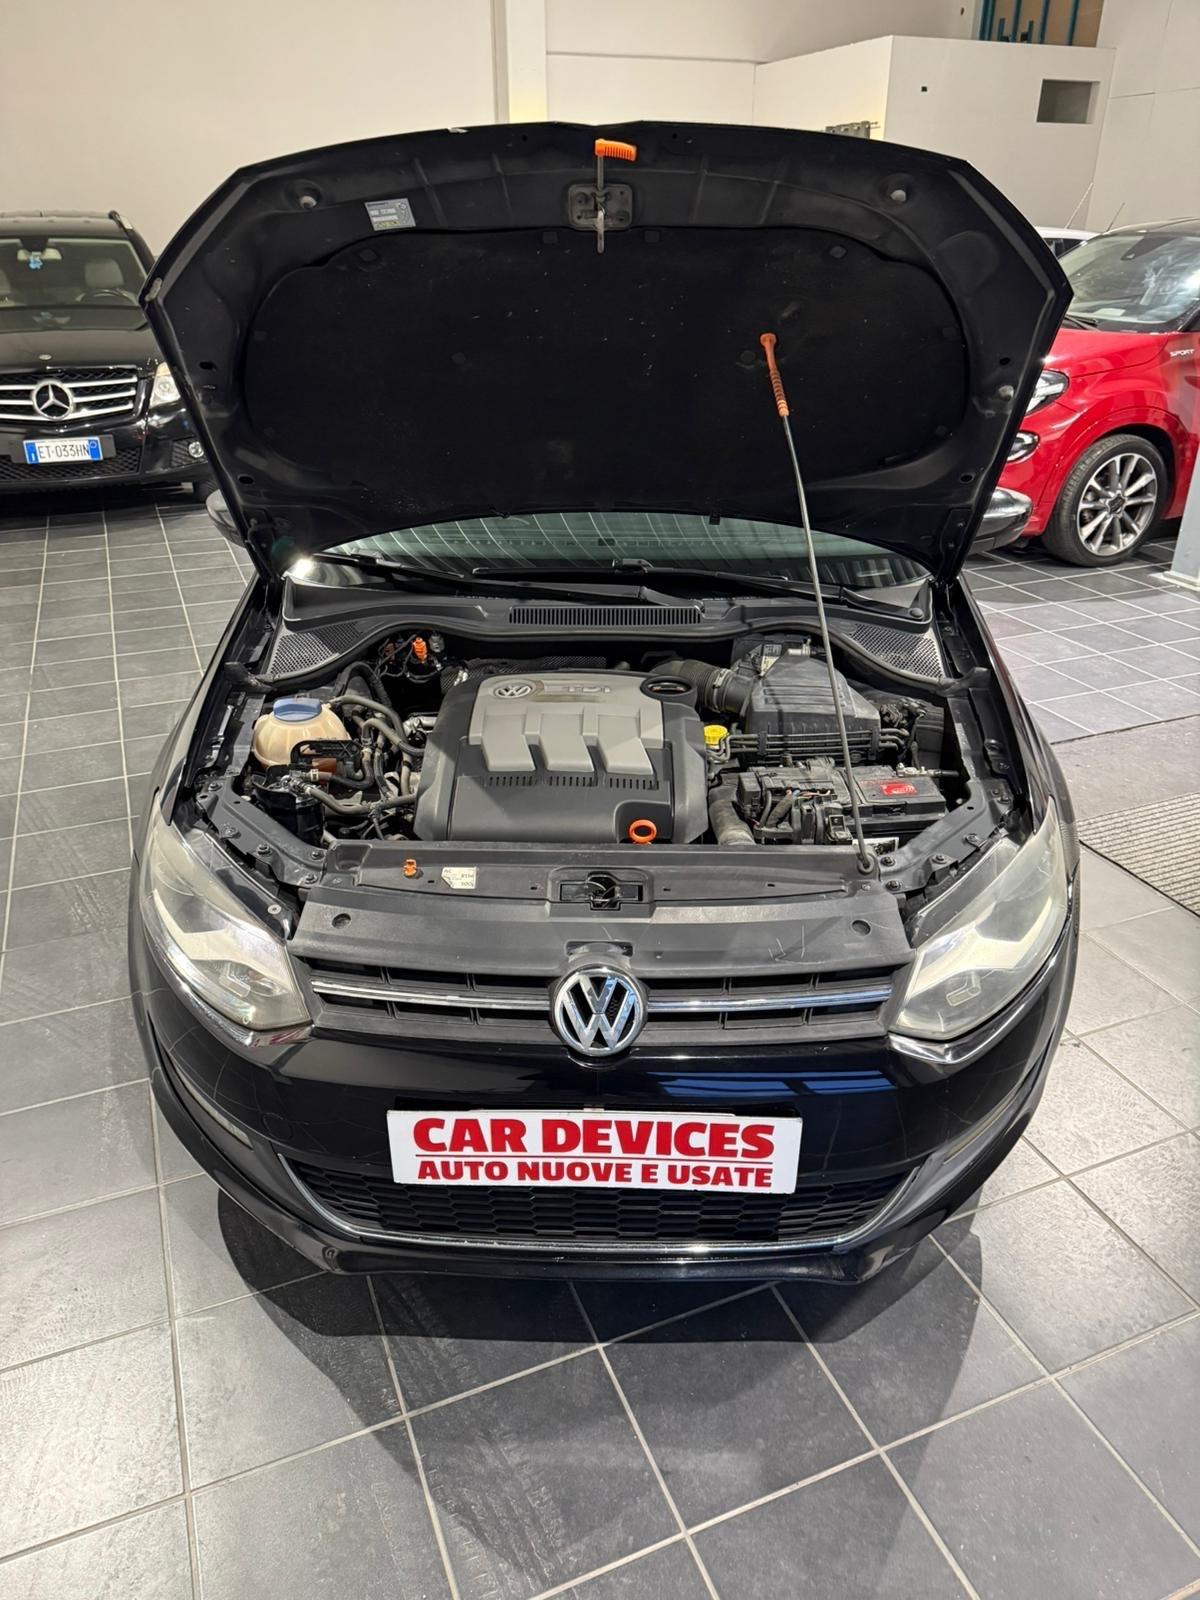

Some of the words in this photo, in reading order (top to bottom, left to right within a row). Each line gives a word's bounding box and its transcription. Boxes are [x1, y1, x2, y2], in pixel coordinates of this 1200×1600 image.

[1170, 349, 1194, 357] SPORT
[413, 1117, 528, 1153] CAR
[541, 1118, 775, 1160] DEVICES
[417, 1160, 509, 1181] AUTO
[517, 1161, 633, 1183] NUOVE
[641, 1163, 659, 1184] E
[667, 1164, 774, 1188] USATE
